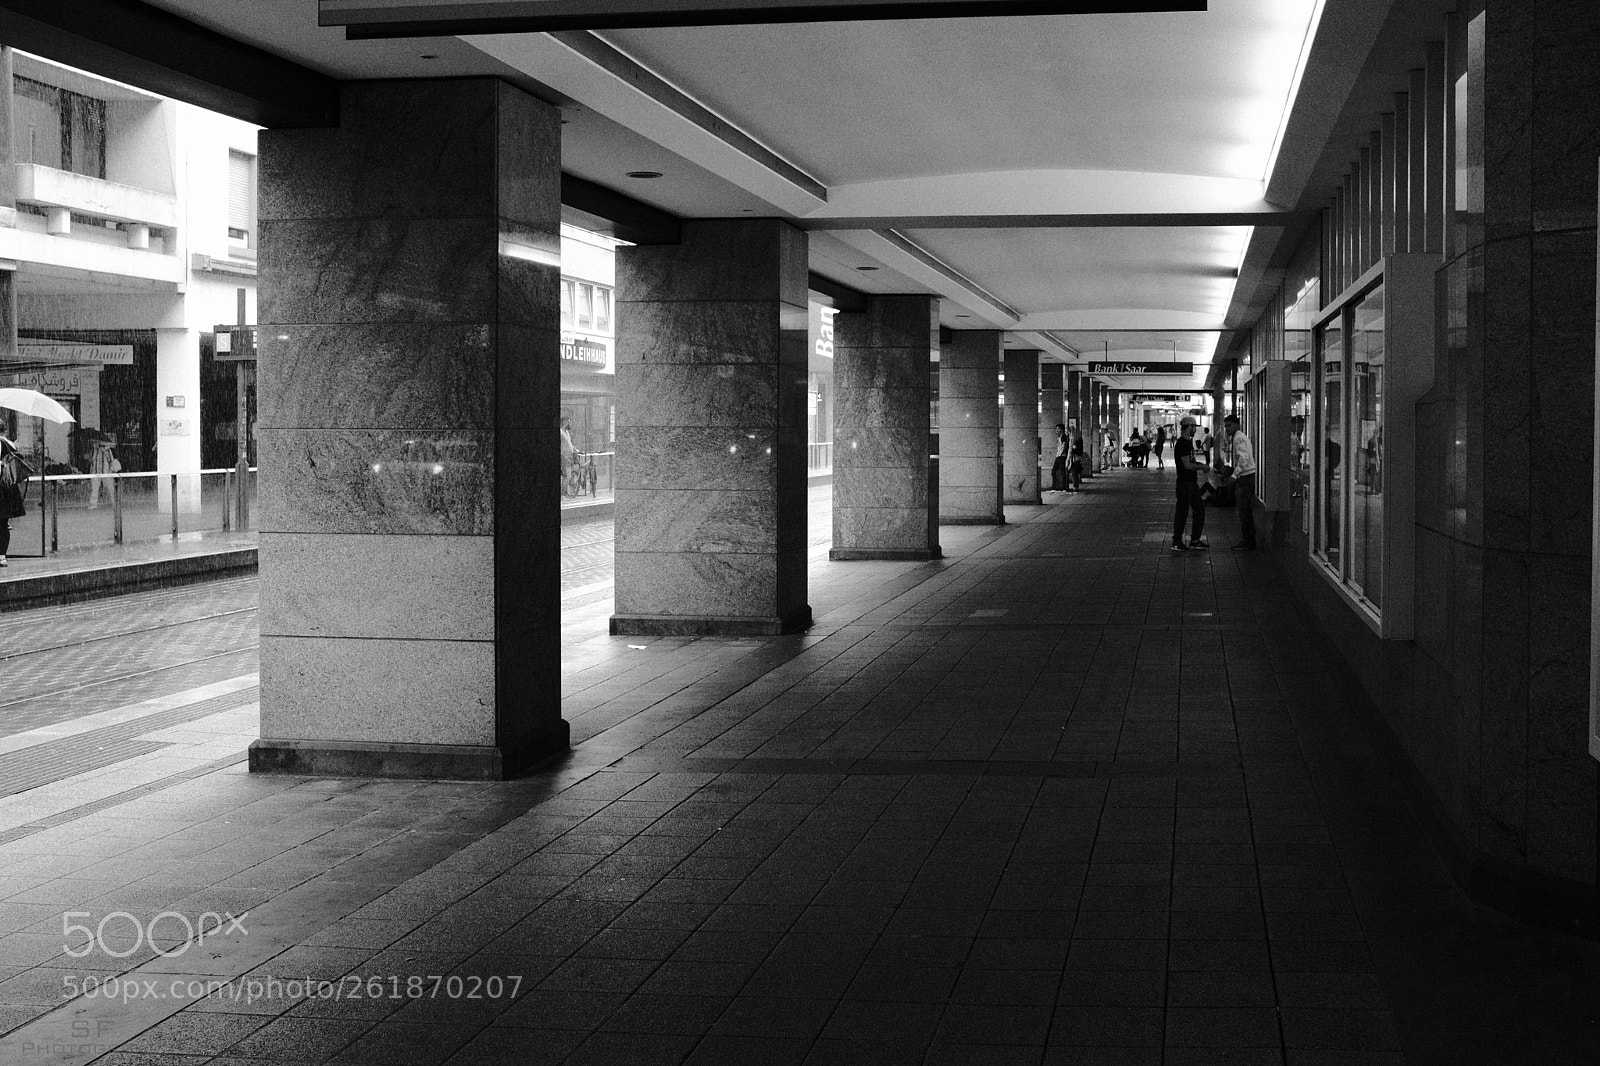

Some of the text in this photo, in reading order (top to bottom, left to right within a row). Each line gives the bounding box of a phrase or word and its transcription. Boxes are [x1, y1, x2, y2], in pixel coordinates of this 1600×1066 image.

[87, 347, 129, 360] Damir
[1094, 363, 1119, 373] Bank
[1125, 363, 1147, 373] Saar
